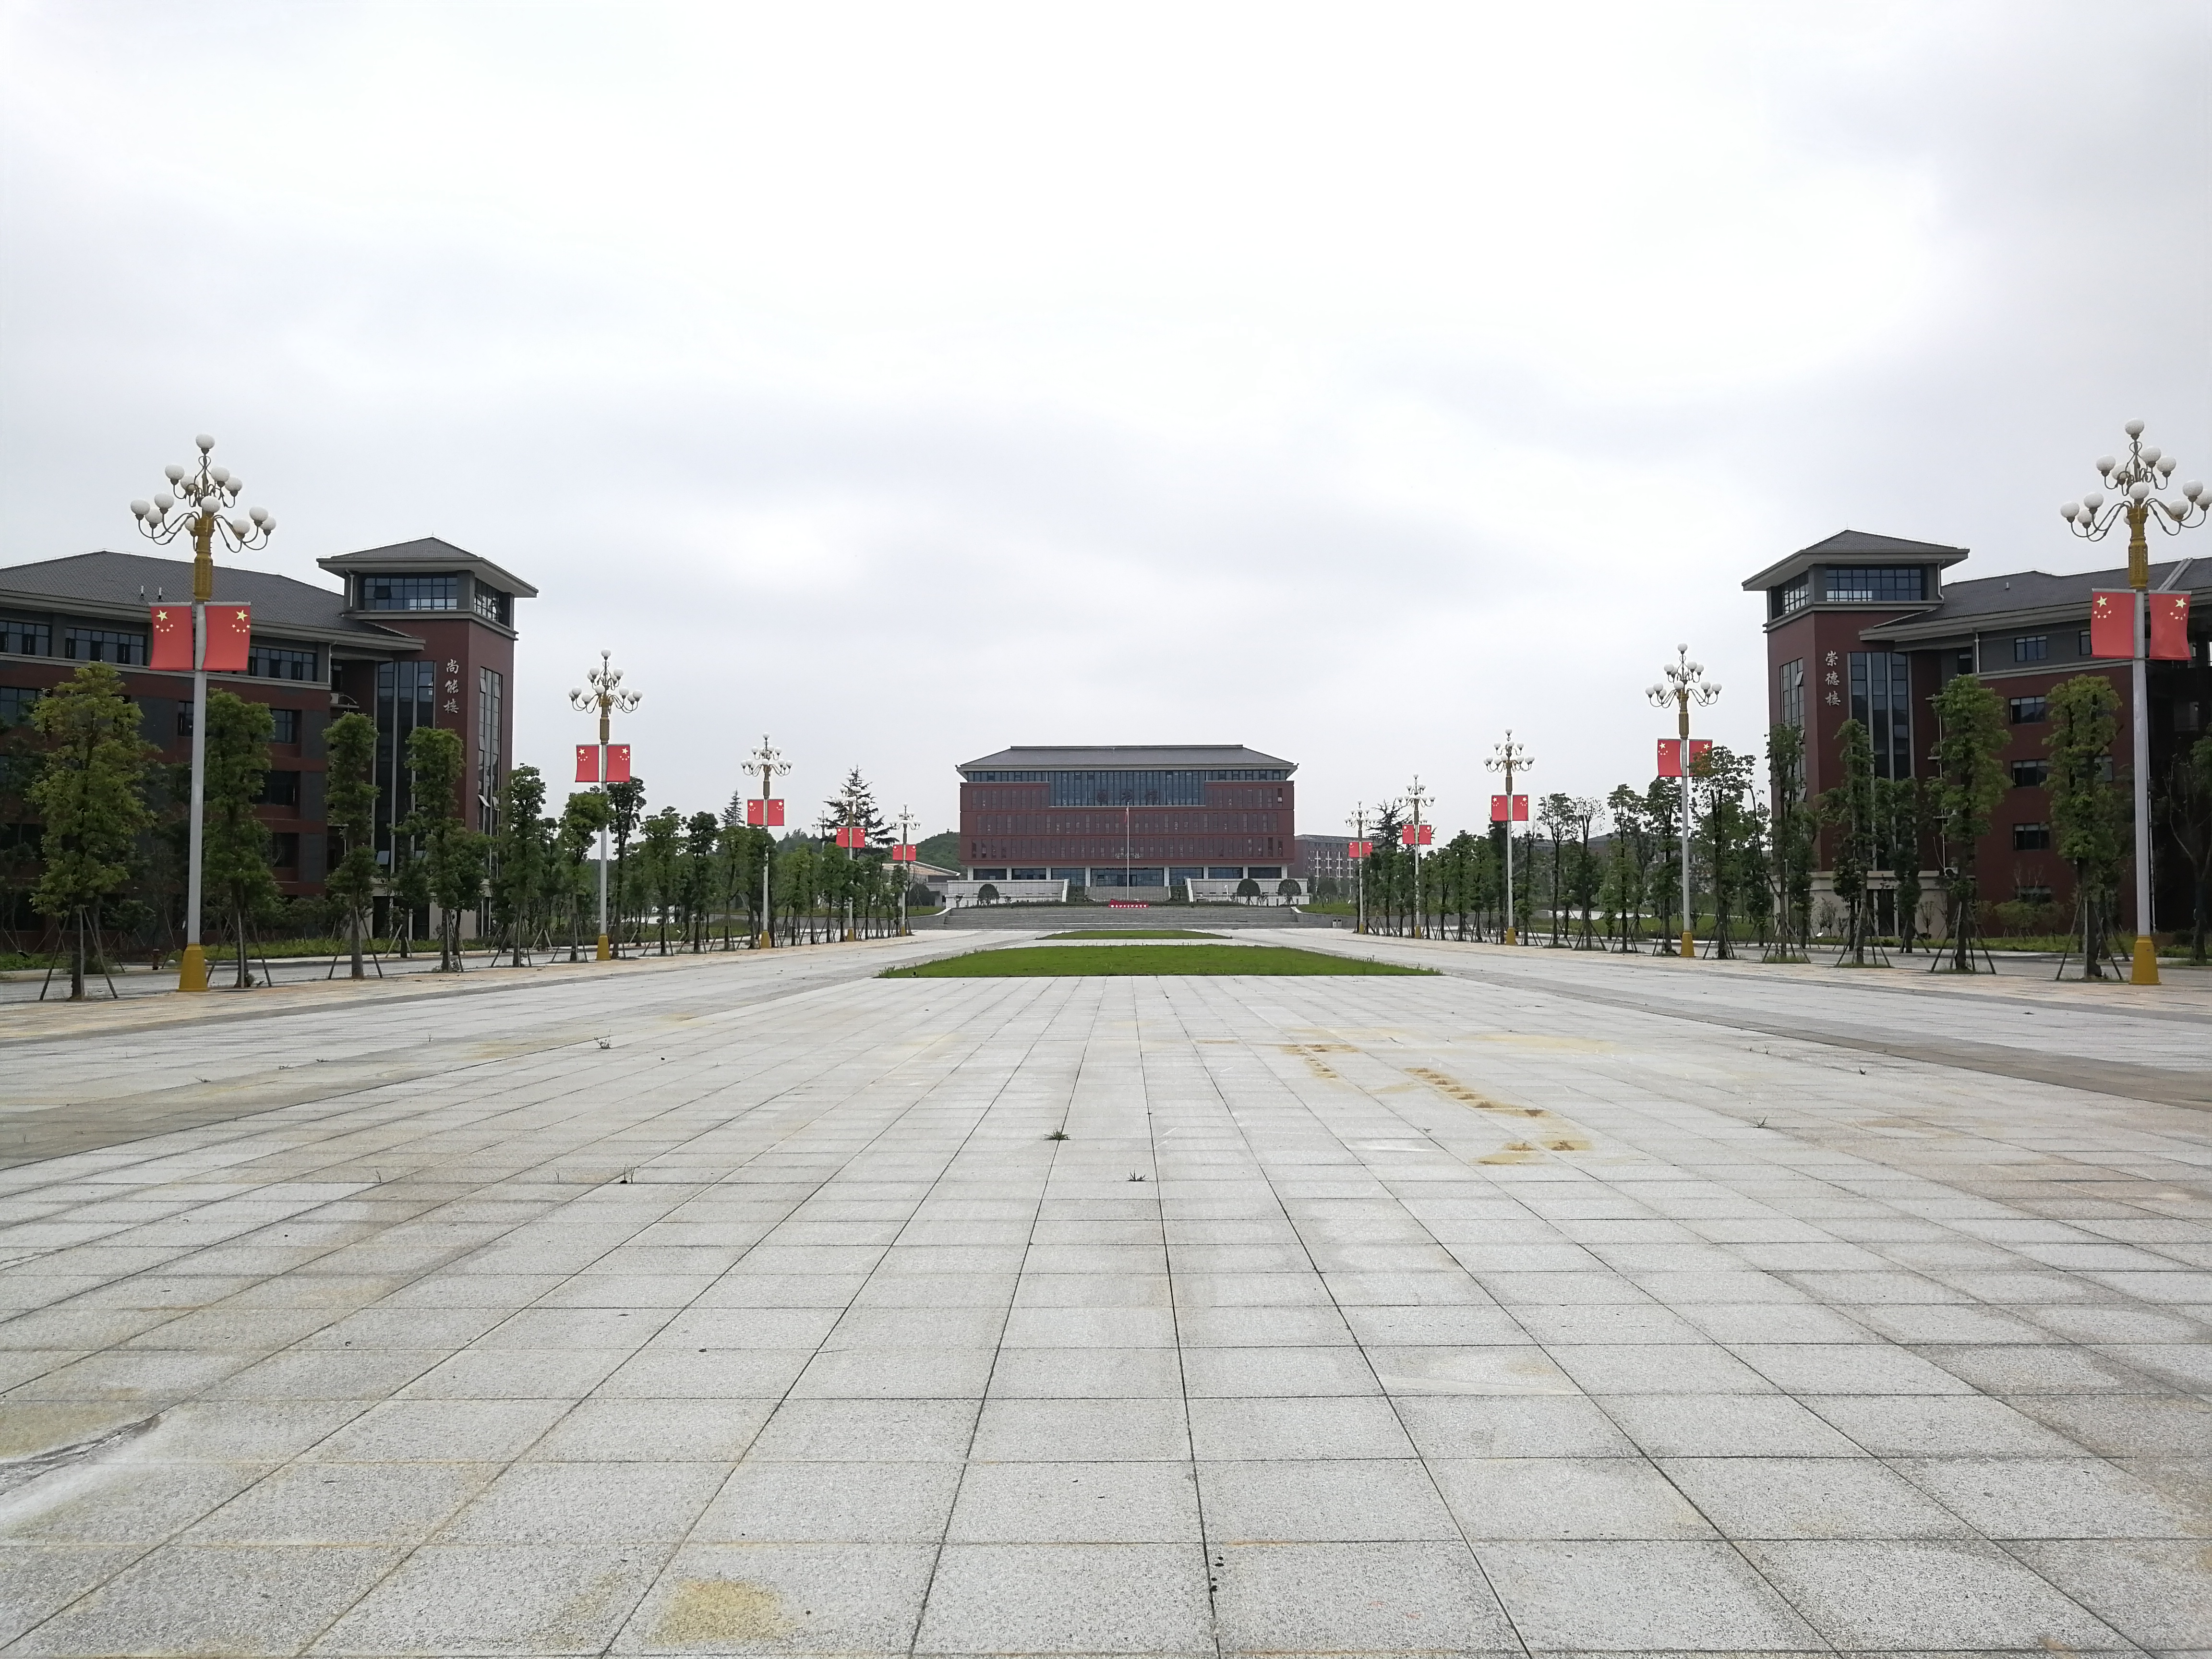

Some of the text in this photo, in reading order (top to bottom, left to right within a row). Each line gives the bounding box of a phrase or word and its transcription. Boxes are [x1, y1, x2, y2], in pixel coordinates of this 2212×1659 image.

[443, 659, 459, 714] 尚能楼
[1825, 650, 1841, 706] 崇德楼
